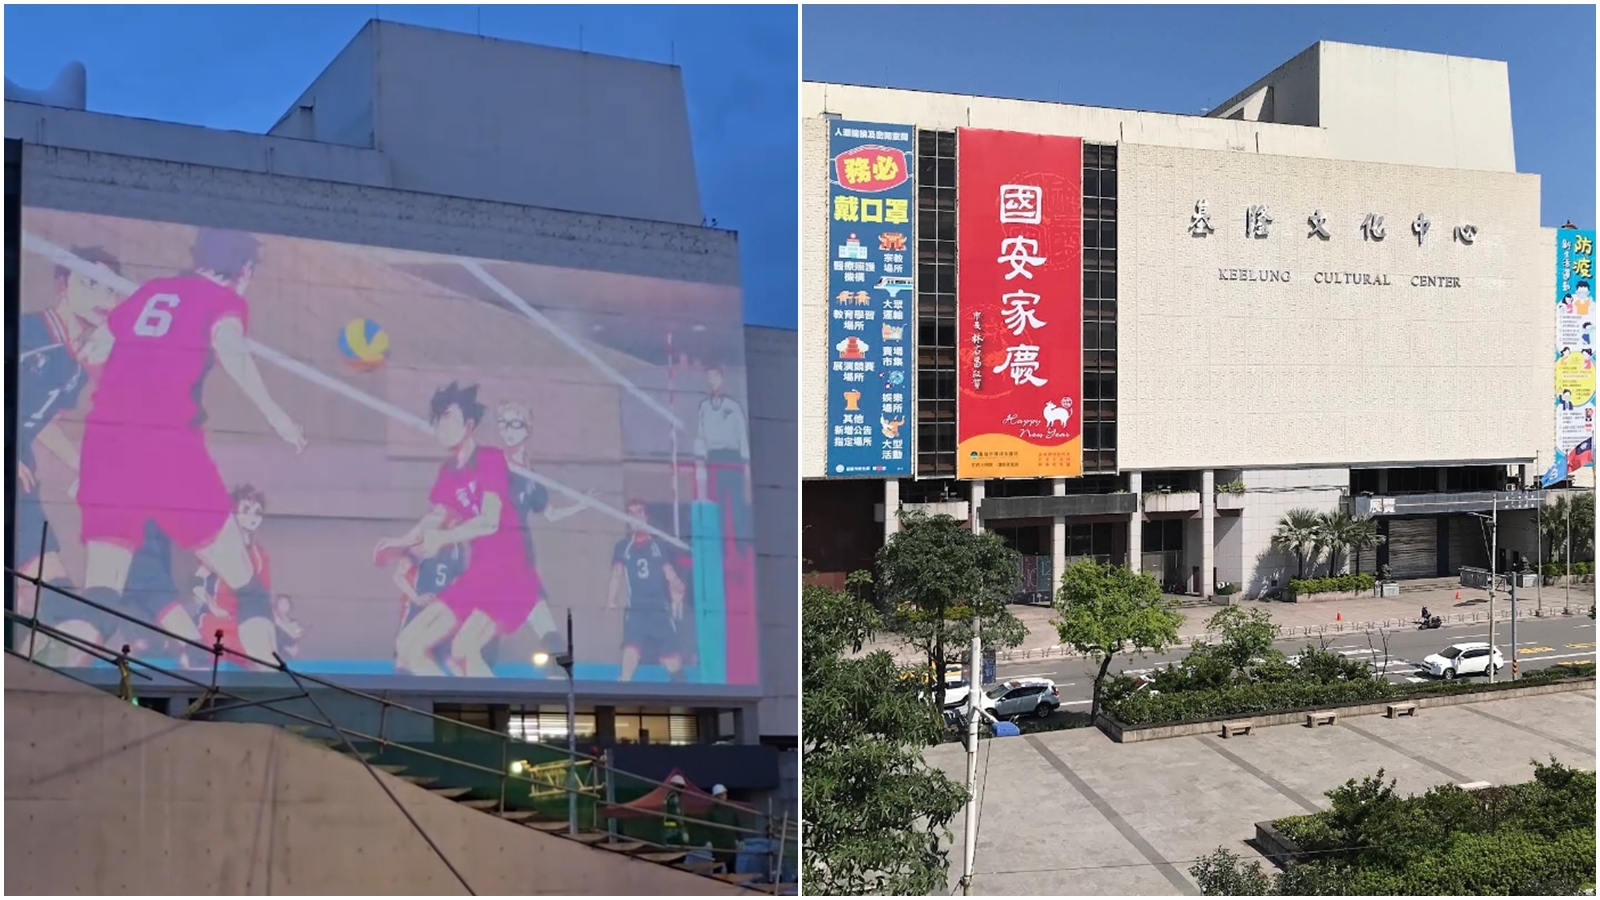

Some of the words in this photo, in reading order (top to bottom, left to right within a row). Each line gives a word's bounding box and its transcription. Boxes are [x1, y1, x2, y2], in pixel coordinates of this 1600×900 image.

[844, 155, 899, 184] 務必
[834, 195, 909, 224] 戴口罩
[1187, 198, 1478, 248] 基隆文化中心
[883, 254, 903, 263] 宗教
[1573, 235, 1593, 279] 防疫
[883, 264, 903, 273] 場所
[1218, 268, 1291, 283] KEELUNG
[1314, 272, 1391, 286] CULTURAL
[1410, 275, 1462, 288] CENTER
[993, 184, 1049, 387] 國安家慶
[133, 293, 181, 337] 6
[833, 310, 875, 320] 教育學習
[883, 310, 904, 320] 運輸
[843, 321, 864, 331] 場所
[882, 346, 903, 357] 賣場
[833, 361, 875, 372] 展演競賽
[882, 357, 903, 367] 市集
[843, 372, 864, 382] 場所
[882, 393, 903, 403] 娛樂
[882, 403, 903, 413] 場所
[843, 414, 864, 424] 其他
[1002, 413, 1041, 427] Happy
[834, 425, 872, 436] 新增公告
[1020, 428, 1043, 438] New
[1046, 427, 1070, 439] Year
[834, 436, 872, 447] 指定場所
[882, 439, 903, 449] 大型
[882, 450, 903, 460] 活動
[636, 558, 650, 579] 3
[435, 563, 448, 586] 5
